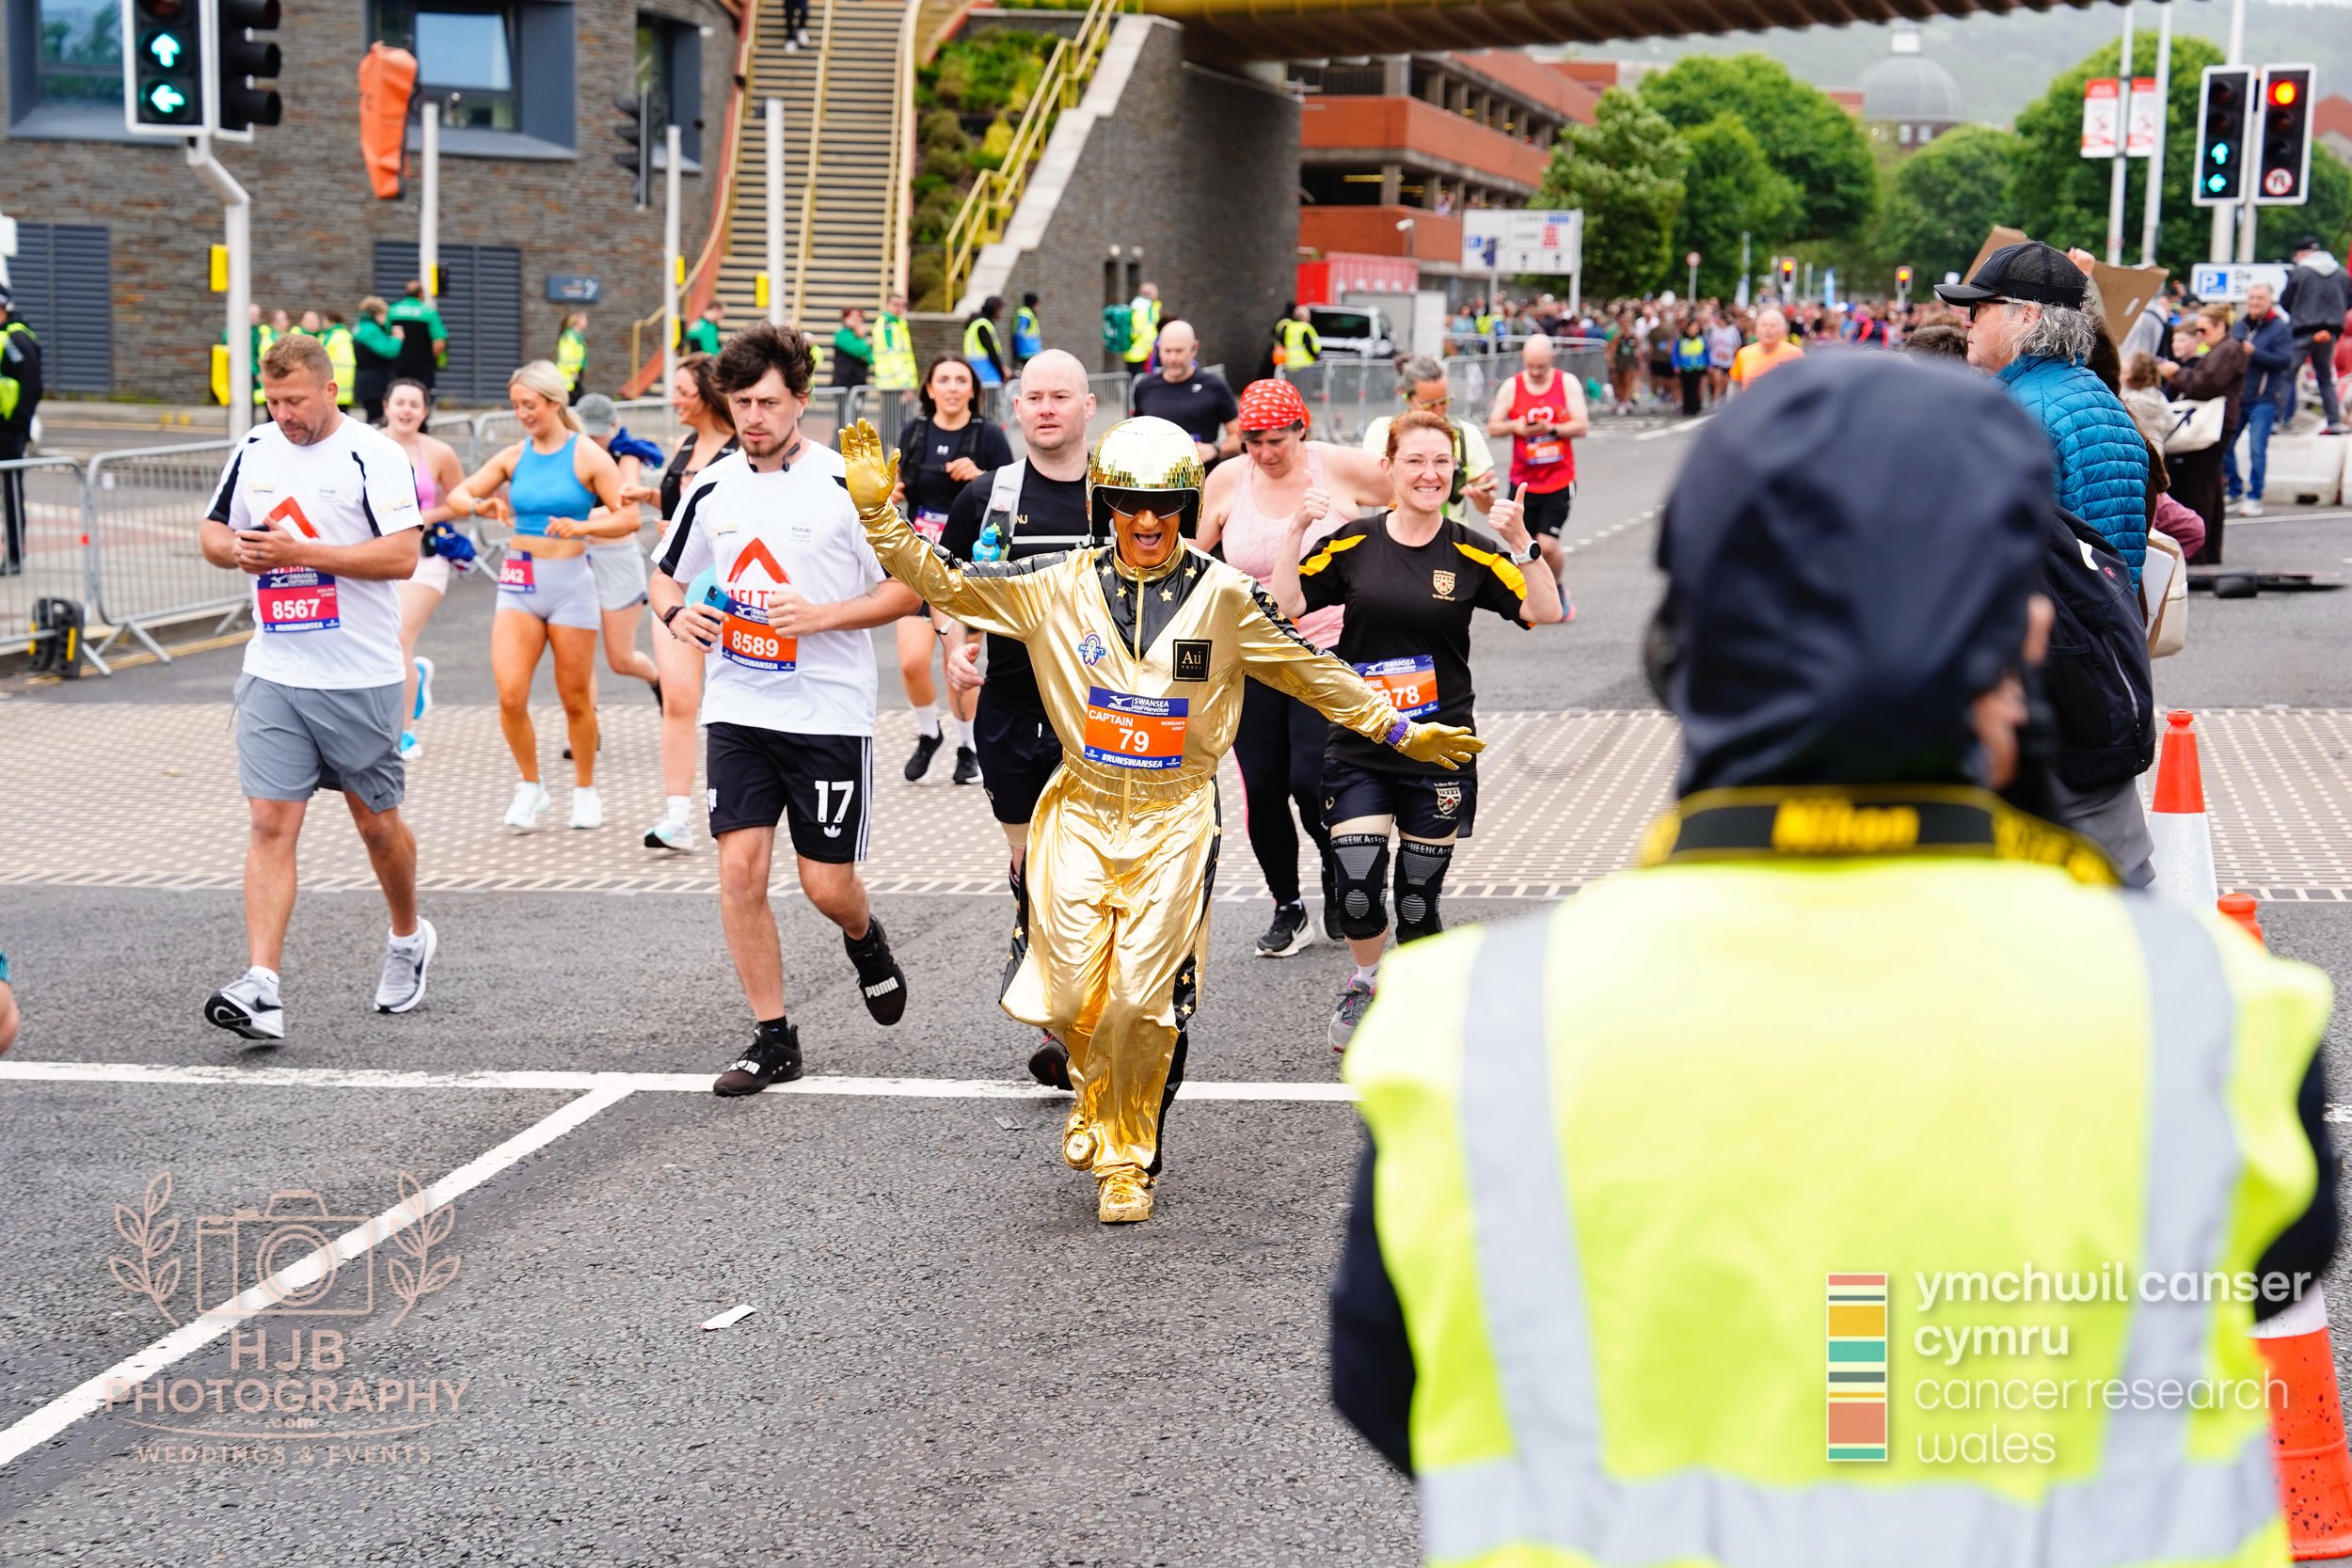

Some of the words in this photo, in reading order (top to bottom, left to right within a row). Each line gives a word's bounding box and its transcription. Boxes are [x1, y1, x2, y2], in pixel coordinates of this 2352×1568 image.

[271, 597, 321, 620] 8567
[731, 629, 780, 658] 8589
[1384, 658, 1416, 668] SWANSEA
[1134, 697, 1169, 708] SWANSEA
[1089, 709, 1134, 727] CAPTAIN
[1119, 727, 1150, 752] 79
[1101, 752, 1163, 768] #RUNSWANSEA
[814, 780, 854, 824] 17
[865, 975, 899, 999] PUMA
